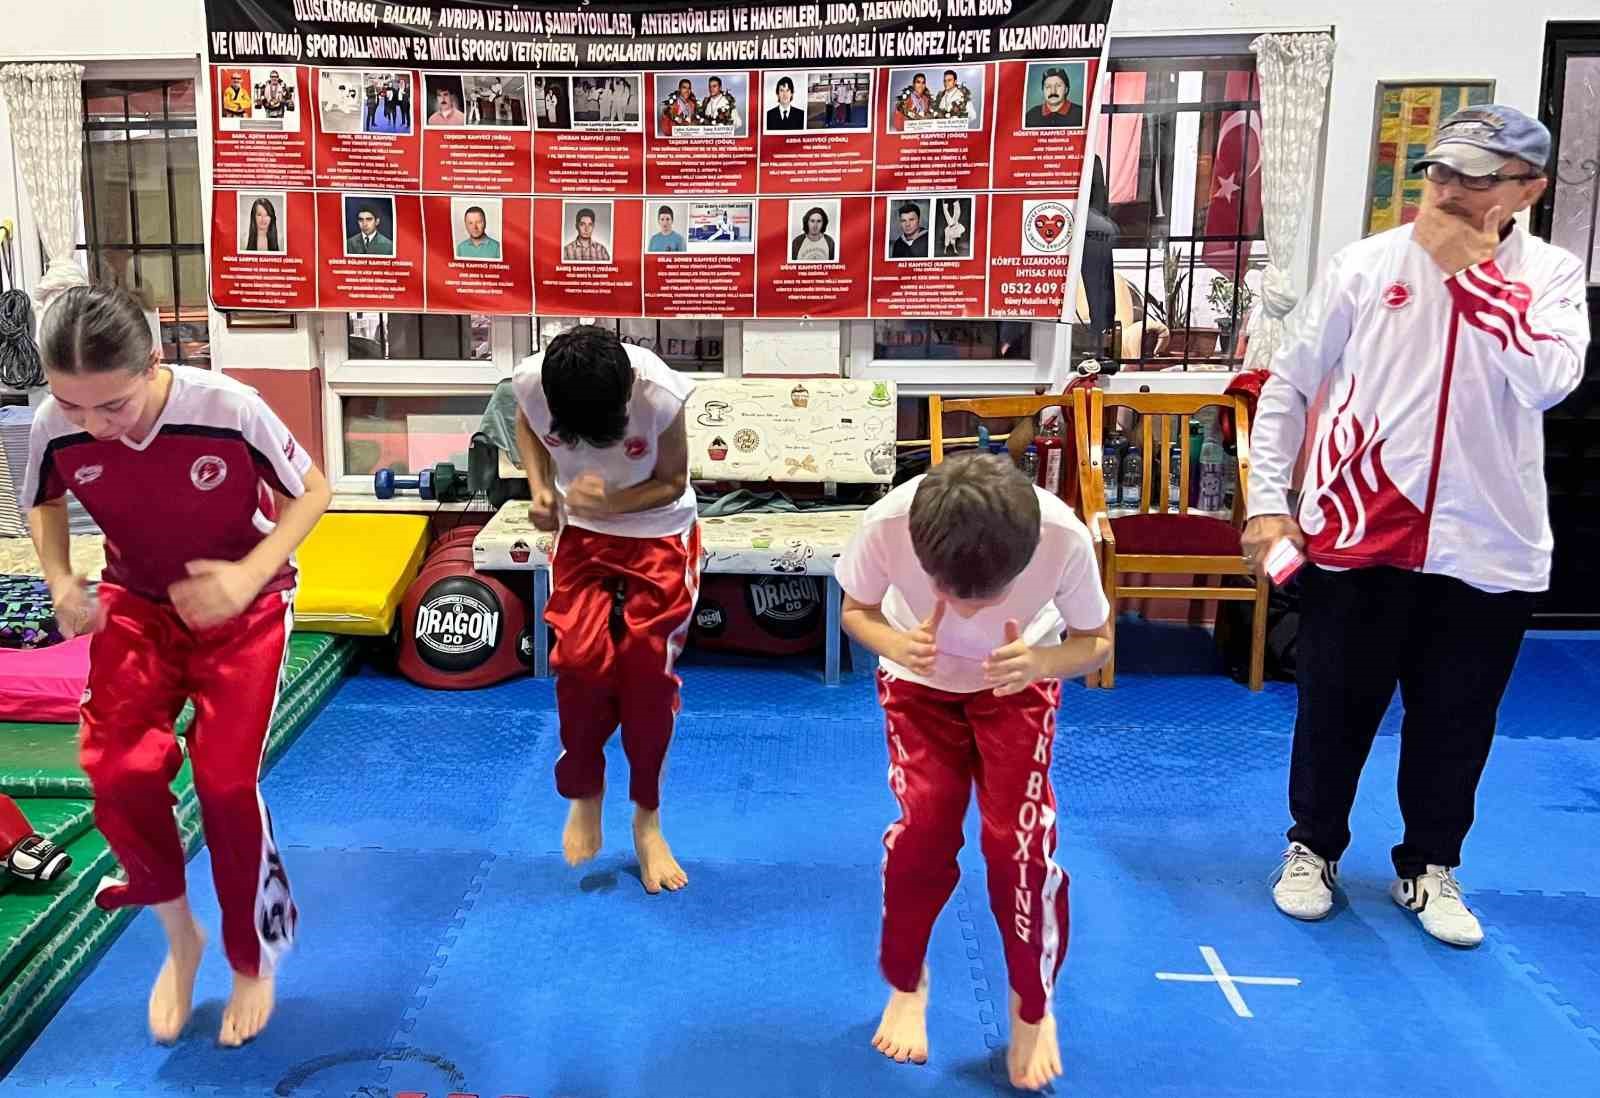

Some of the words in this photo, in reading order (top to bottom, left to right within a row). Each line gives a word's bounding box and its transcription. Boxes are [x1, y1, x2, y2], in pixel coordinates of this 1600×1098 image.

[382, 4, 433, 28] BALKAN,
[438, 7, 485, 31] AVRUPA
[487, 10, 503, 32] VE
[504, 4, 544, 34] DÜNYA
[546, 7, 636, 38] ŞAMPİYONLARI,
[641, 6, 731, 34] ANTRENÖRLERİ
[732, 8, 748, 31] VE
[750, 0, 823, 30] HAKEMLERİ,
[824, 3, 860, 26] JUDO,
[862, 0, 942, 22] TAEKWONDO,
[211, 32, 228, 56] VE
[306, 36, 338, 58] SPOR
[413, 38, 428, 59] 52
[430, 32, 460, 61] MİLLİ
[461, 38, 509, 62] SPORCU
[511, 38, 579, 68] YETİŞTİREN,
[587, 43, 655, 62] HOCALARIN
[657, 42, 702, 62] HOCASI
[706, 36, 759, 61] KAHVECİ
[761, 32, 824, 60] AİLESİ'NİN
[825, 27, 877, 58] KOCAELİ
[879, 33, 895, 56] VE
[897, 27, 945, 56] KÖRFEZ
[946, 24, 991, 61] İLÇE'YE
[999, 23, 1105, 52] KAZANDIRDIKLAR
[992, 256, 1020, 266] KÖRFEZ
[1001, 282, 1031, 294] 0532
[1034, 282, 1057, 293] 609
[750, 577, 820, 616] DRAGON
[786, 600, 802, 611] DO
[416, 605, 499, 647] DRAGON
[443, 633, 463, 645] DO
